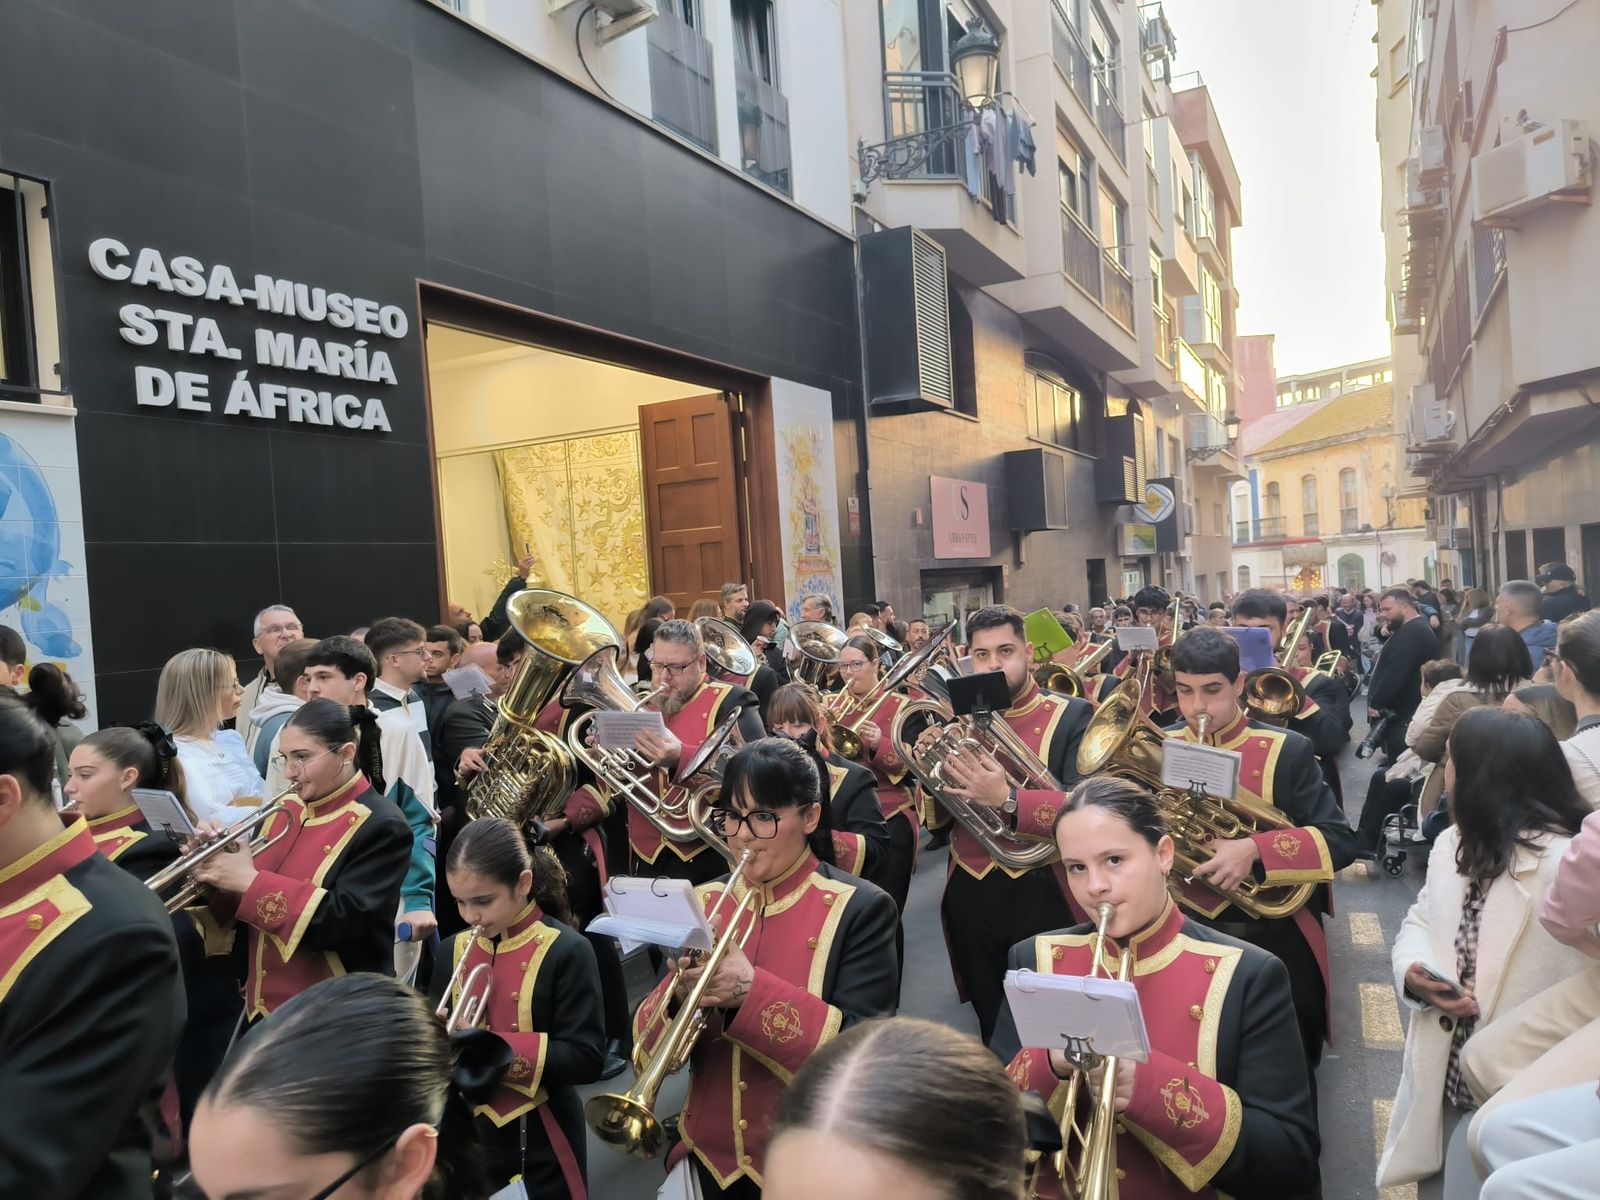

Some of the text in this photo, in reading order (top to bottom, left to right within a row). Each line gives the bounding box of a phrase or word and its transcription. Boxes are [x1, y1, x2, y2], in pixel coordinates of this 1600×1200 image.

[88, 237, 409, 340] CASA-MUSEO
[119, 303, 399, 386] STA. MARÍA
[134, 365, 393, 433] DE ÁFRICA
